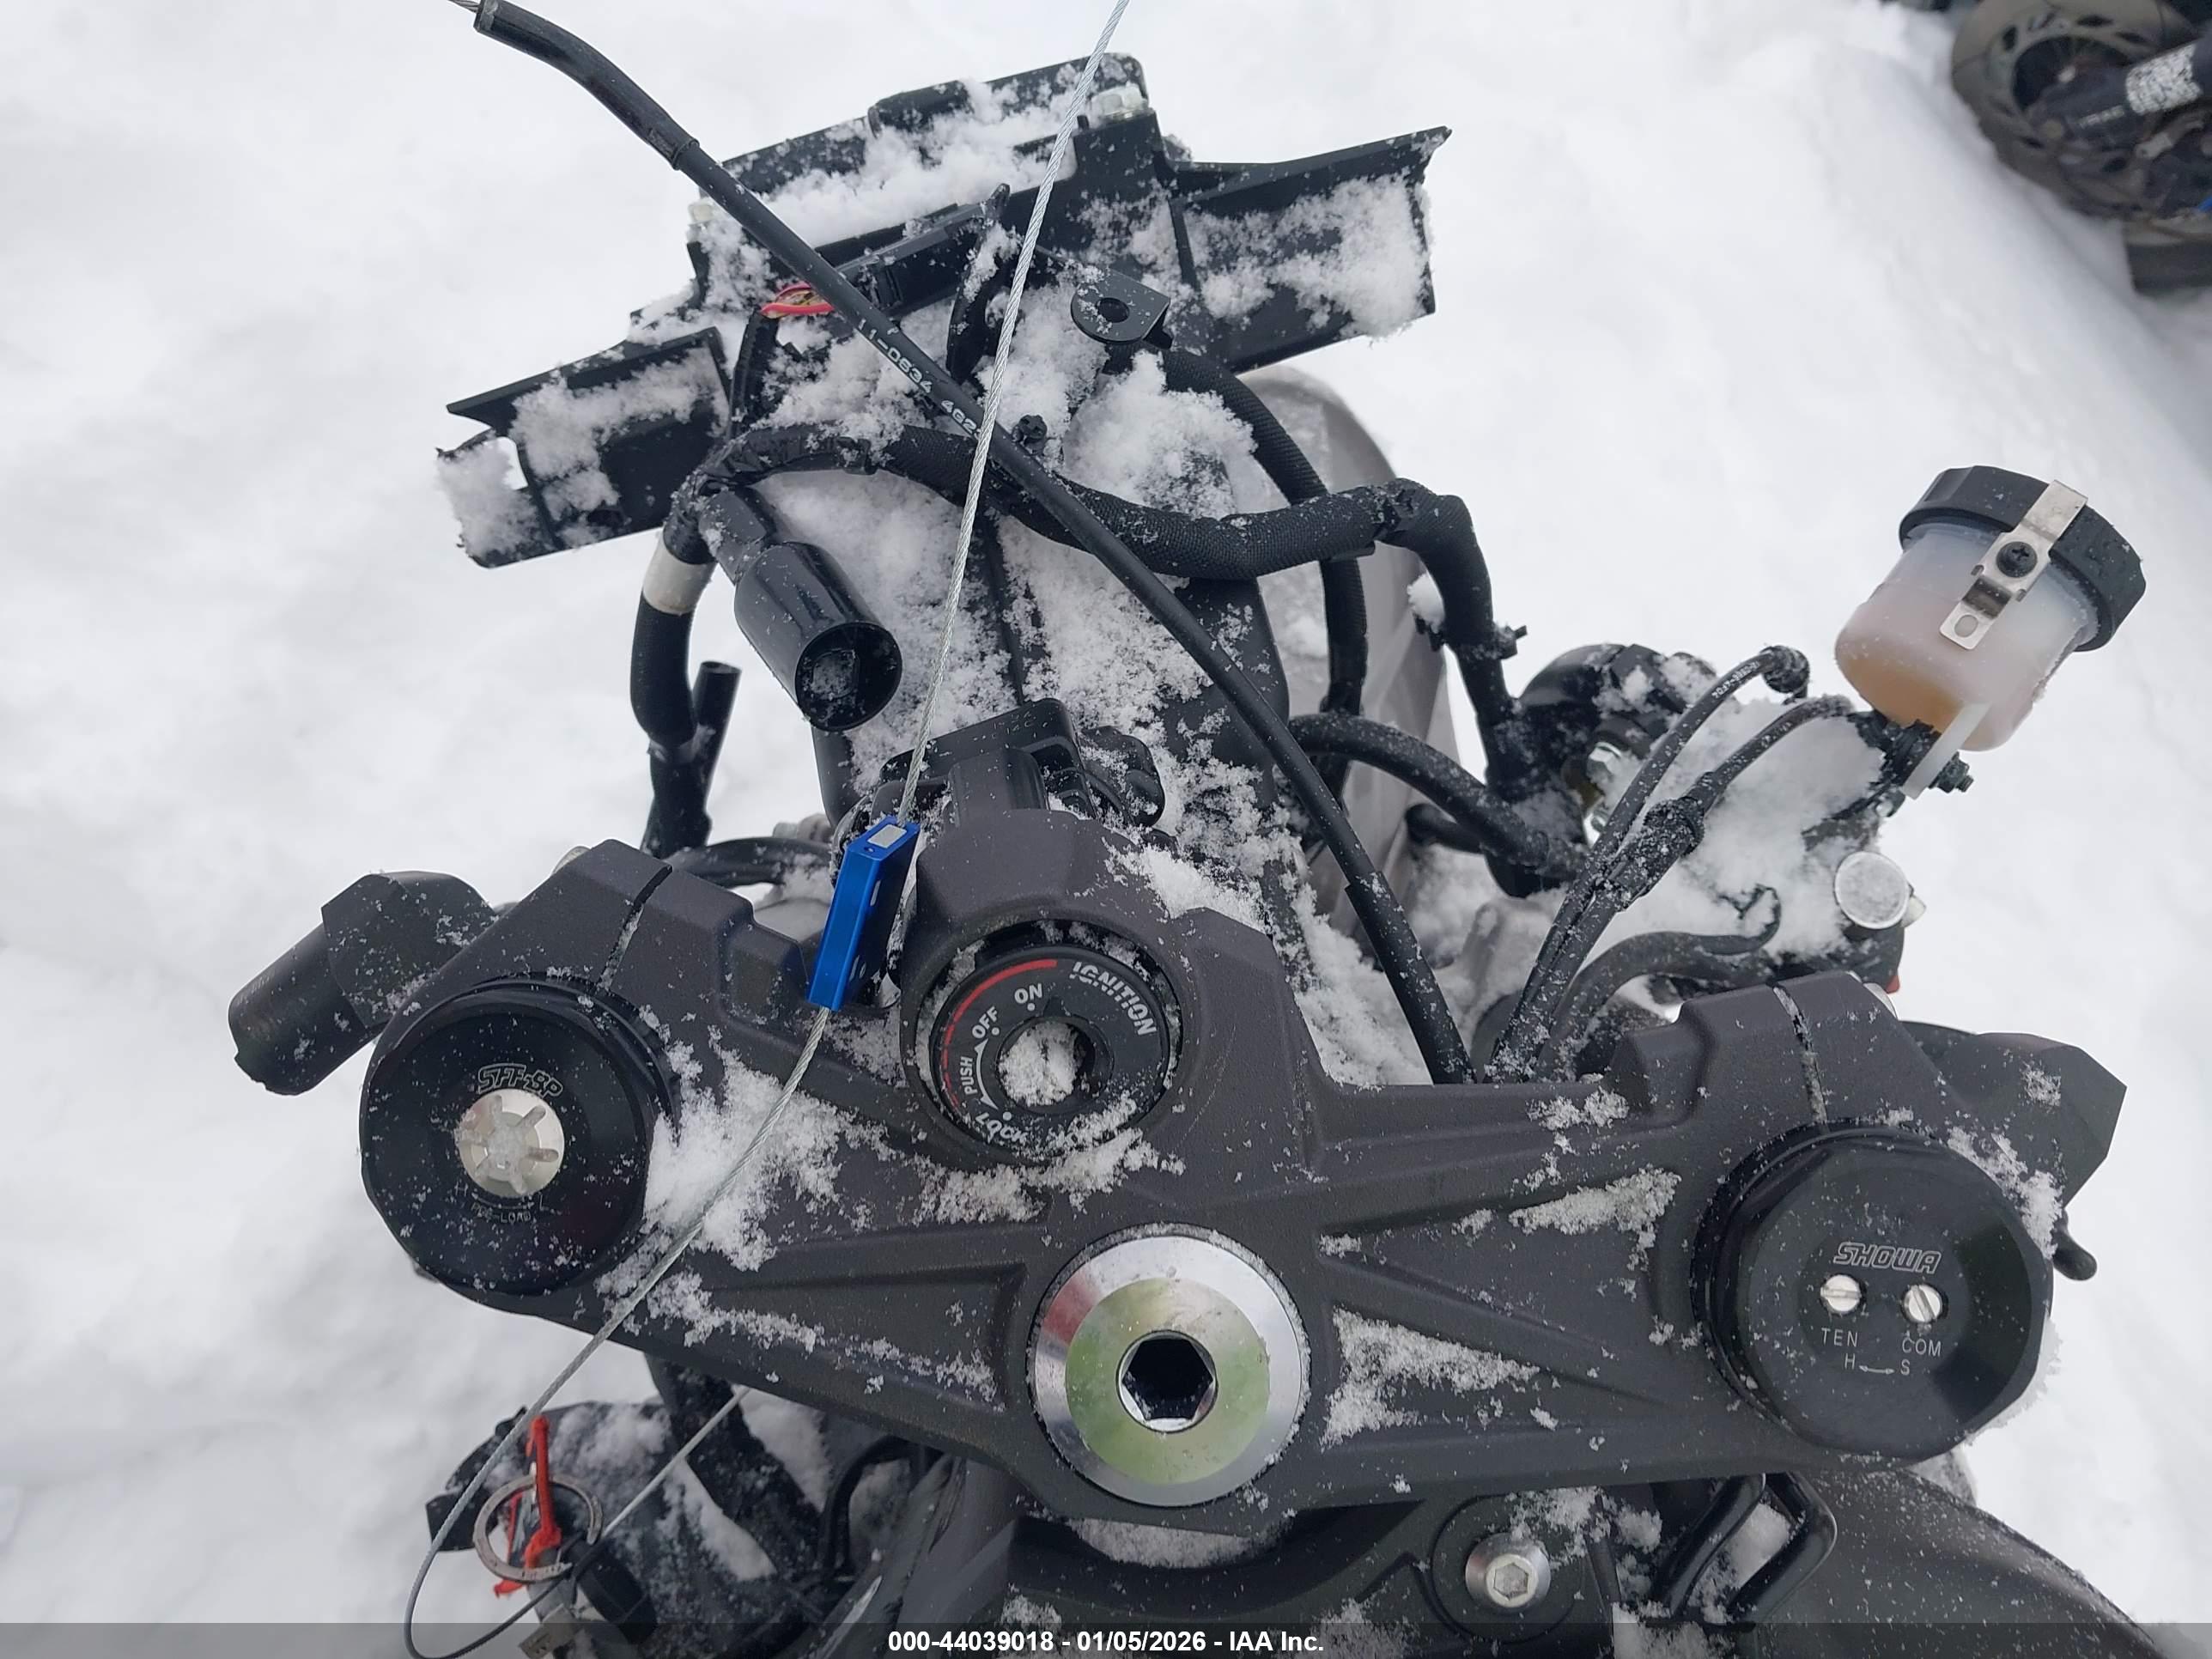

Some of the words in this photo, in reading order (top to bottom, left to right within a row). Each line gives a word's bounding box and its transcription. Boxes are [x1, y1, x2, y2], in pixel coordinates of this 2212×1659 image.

[1014, 983, 1042, 1004] ON
[1069, 962, 1158, 1036] IGNITION
[971, 1006, 998, 1039] OFF
[960, 1056, 978, 1095] PUSH
[1833, 1242, 1942, 1274] SHOWA
[1821, 1328, 1858, 1346] TEN
[1902, 1338, 1942, 1357] COM
[1844, 1353, 1856, 1370] H
[1900, 1359, 1911, 1375] S
